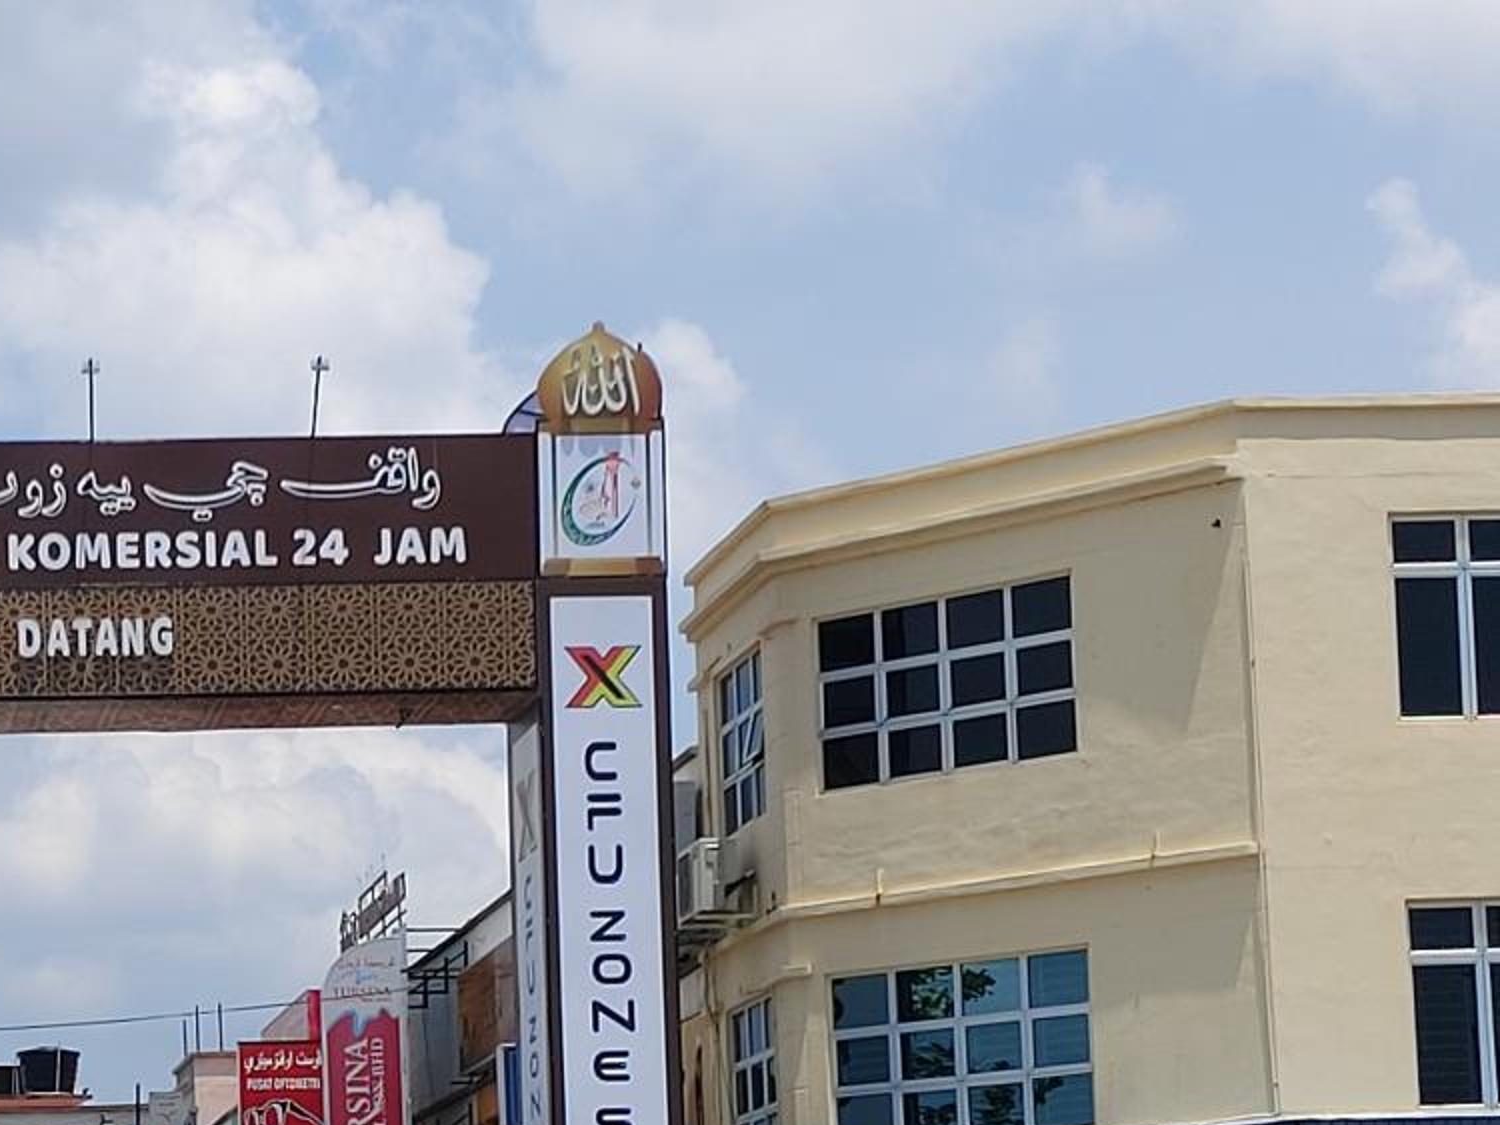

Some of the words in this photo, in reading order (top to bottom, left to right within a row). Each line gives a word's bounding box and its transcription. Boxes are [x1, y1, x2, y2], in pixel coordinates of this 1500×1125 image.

[7, 530, 278, 571] KOMERSIAL
[292, 528, 349, 566] 24
[373, 526, 467, 565] JAM
[17, 616, 174, 657] DATANG
